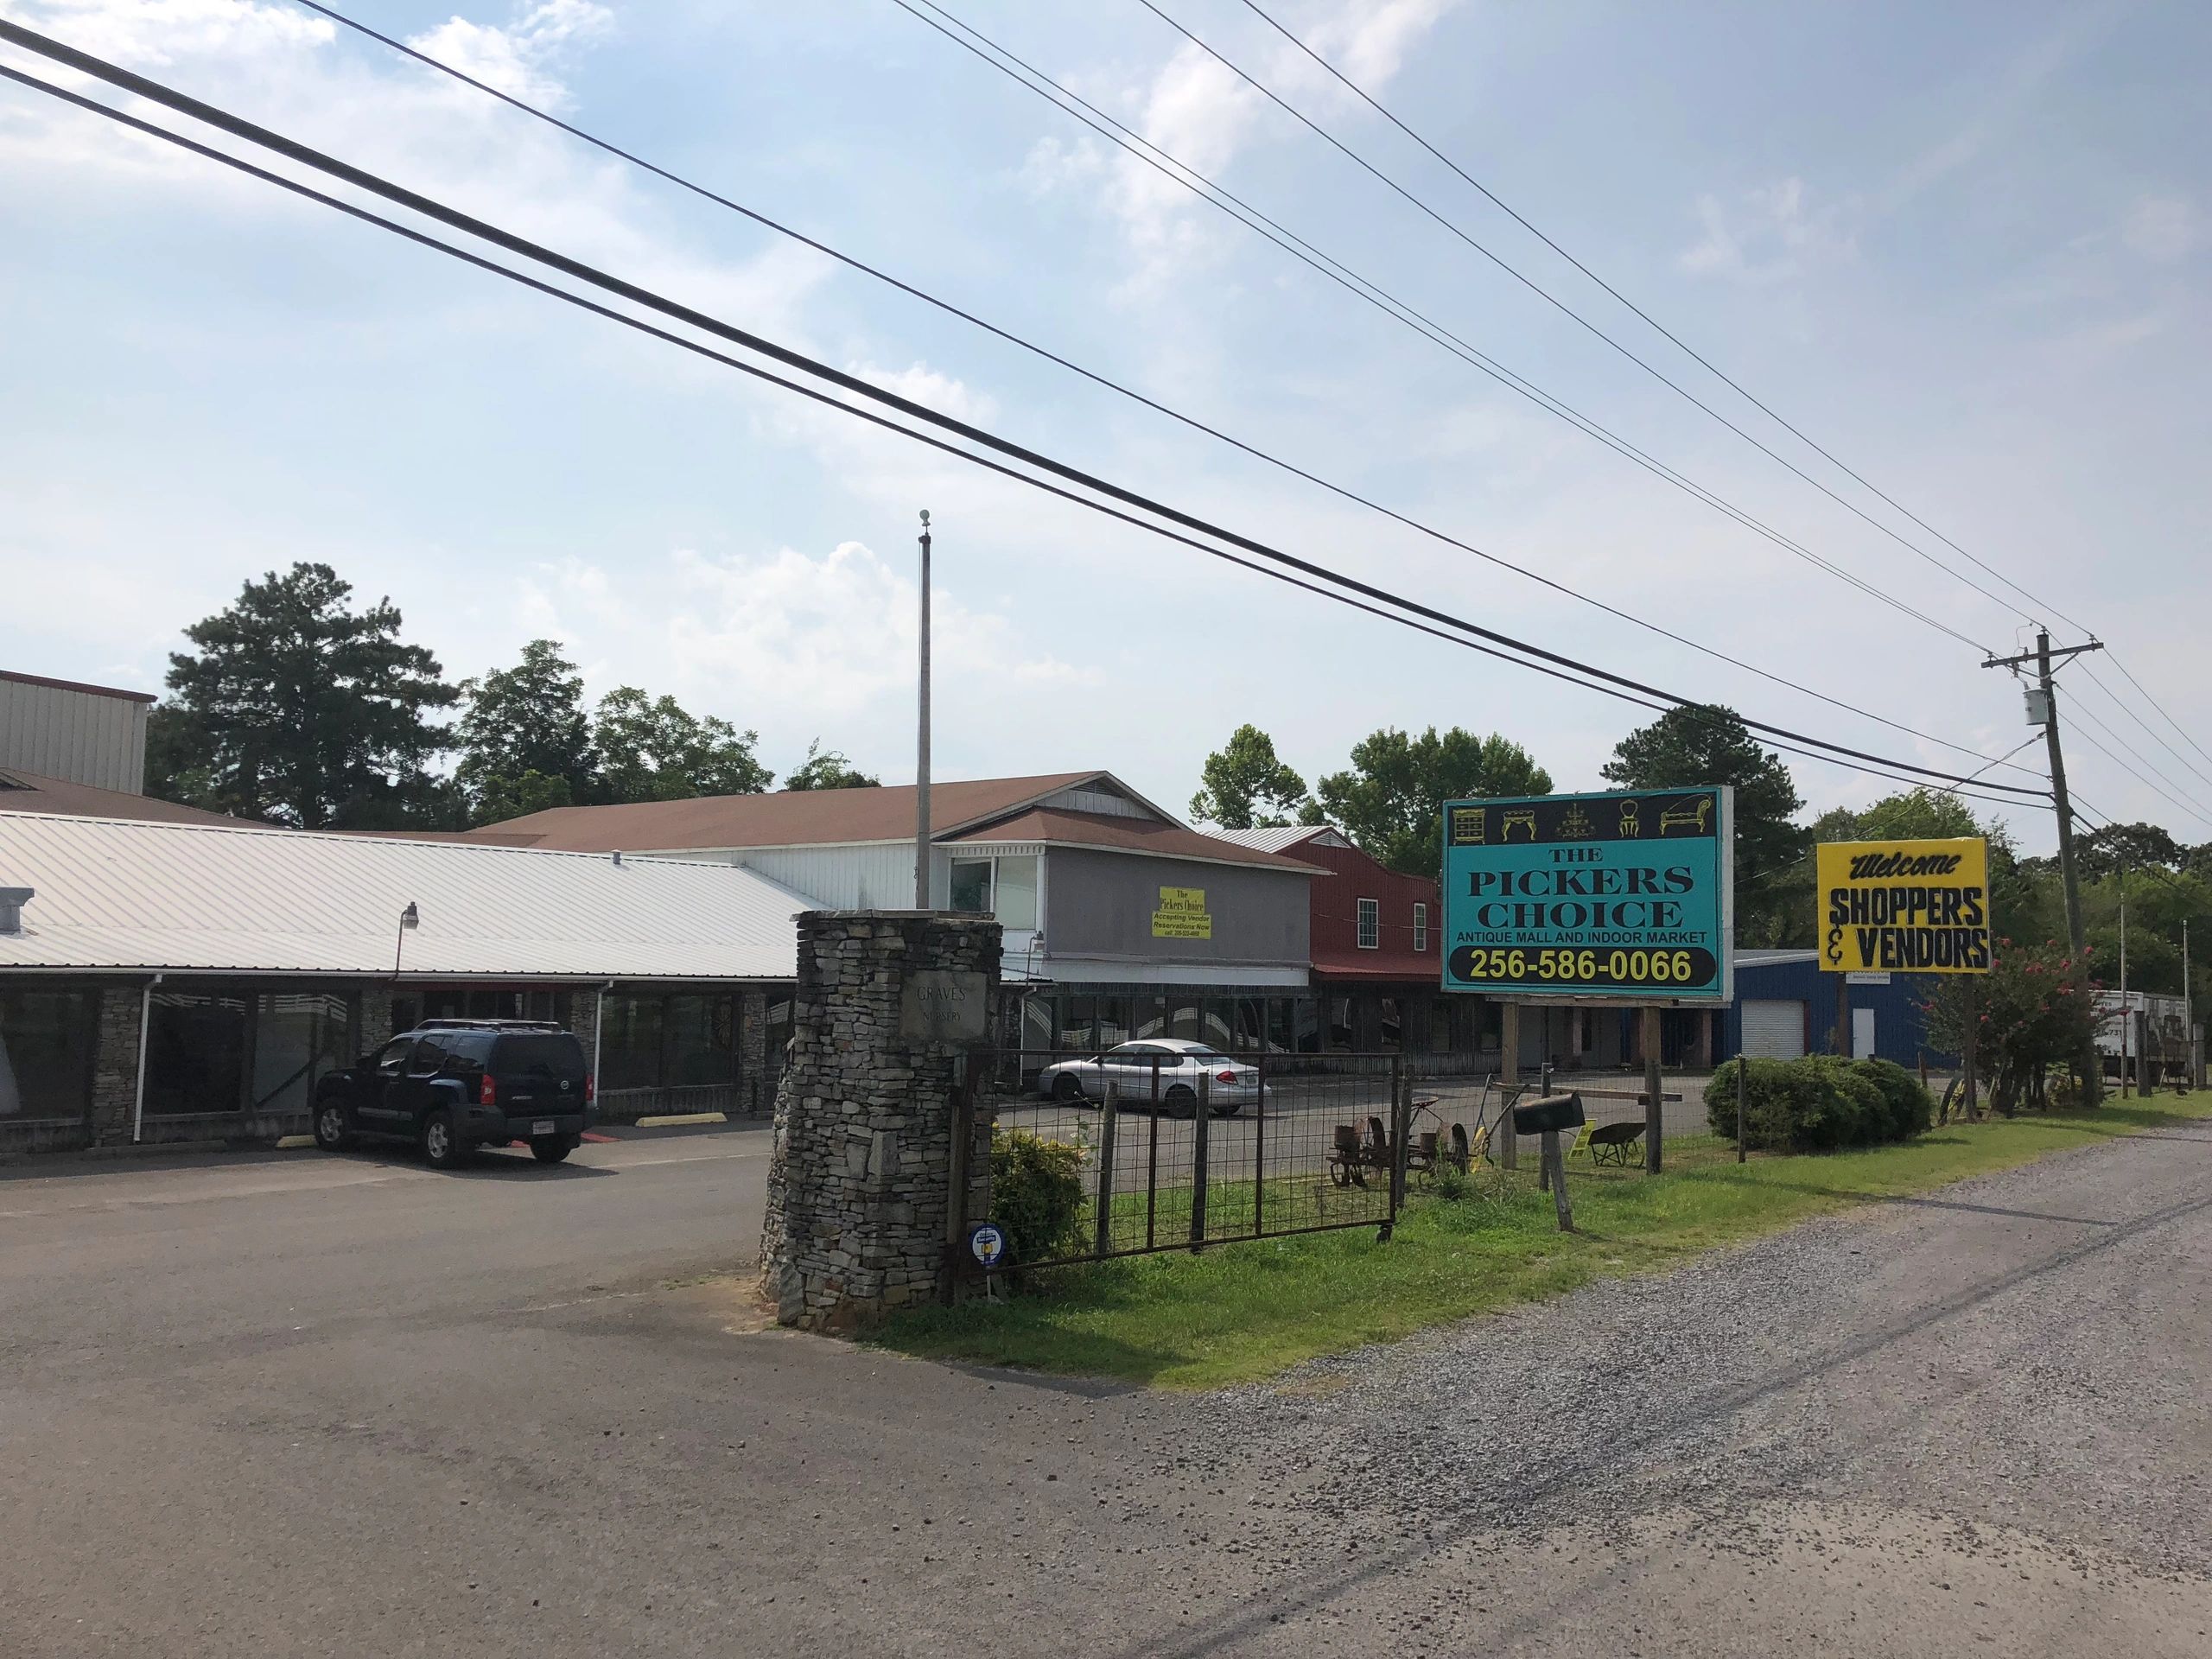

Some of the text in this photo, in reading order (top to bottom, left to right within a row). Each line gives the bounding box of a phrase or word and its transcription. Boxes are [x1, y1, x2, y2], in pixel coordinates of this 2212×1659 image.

[1548, 848, 1603, 863] THE
[1849, 852, 1961, 880] Welcome
[1467, 866, 1694, 897] PICKERS
[1176, 889, 1188, 898] The
[1160, 898, 1184, 911] Pickers
[1829, 887, 1983, 926] SHOPPERS
[1154, 912, 1186, 923] Accepting
[1478, 901, 1683, 929] CHOICE
[1154, 921, 1195, 930] Reservations
[1456, 931, 1707, 944] ANTIQUE MALL AND INDOOR MARKET
[1827, 926, 1988, 969] & VENDORS
[1470, 950, 1692, 981] 256-586-0066
[917, 987, 966, 1001] GRAVES
